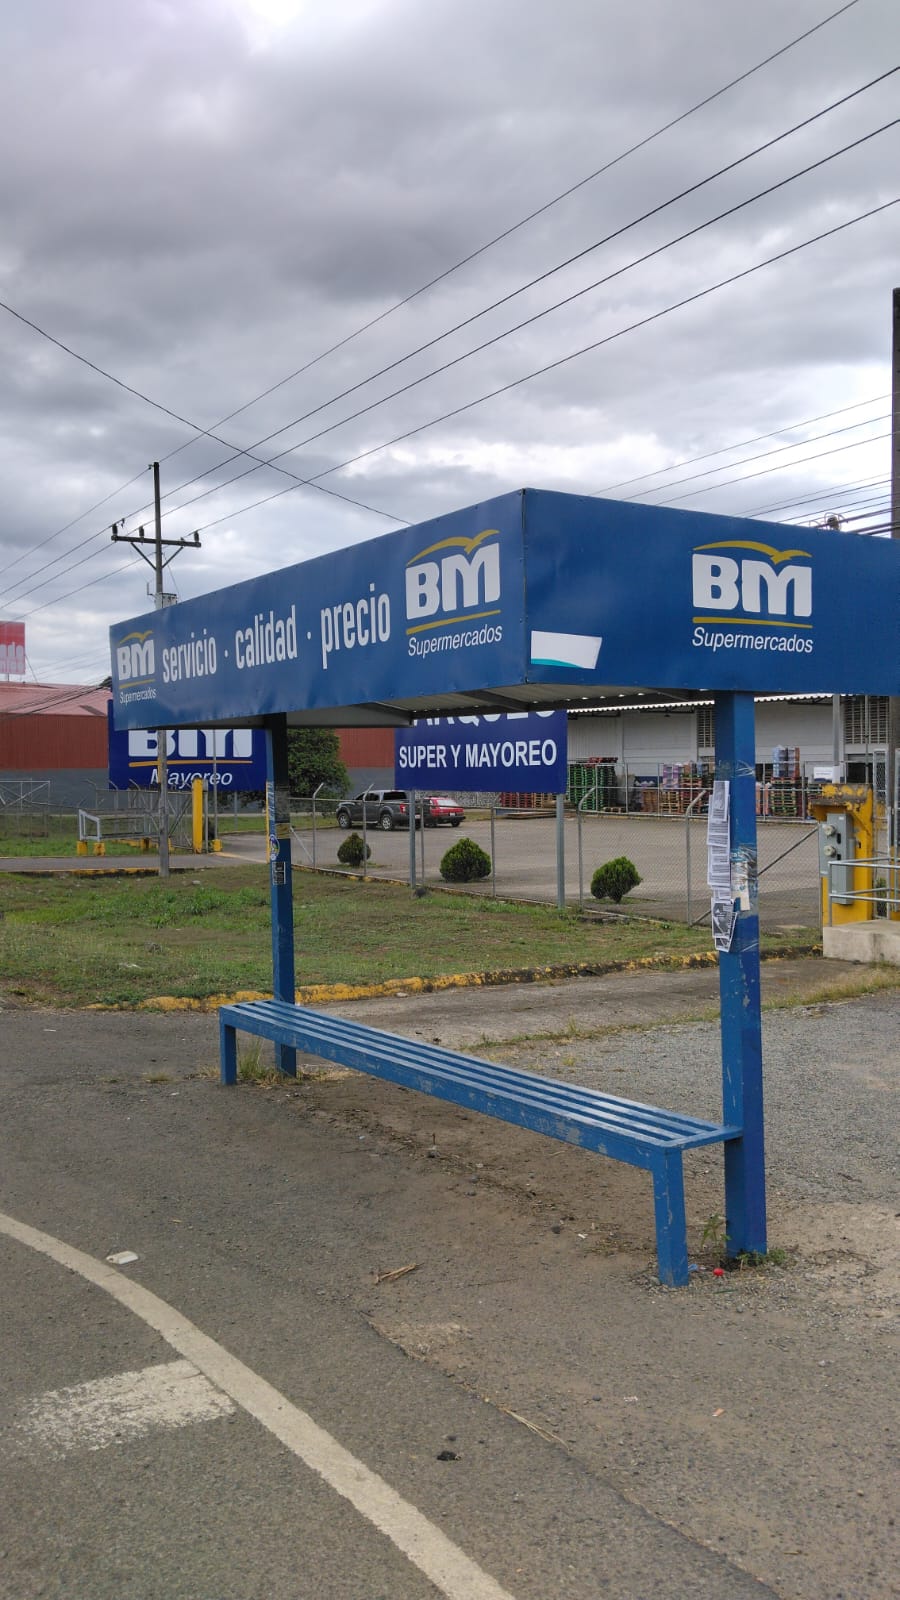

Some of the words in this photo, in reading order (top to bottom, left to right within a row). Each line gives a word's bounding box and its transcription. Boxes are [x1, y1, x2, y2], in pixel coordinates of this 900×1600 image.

[405, 542, 500, 620] BM
[692, 553, 812, 617] BM
[162, 628, 217, 683] servicio
[235, 605, 298, 670] calidad
[320, 583, 391, 669] precio
[407, 623, 503, 657] Supermercados
[692, 626, 814, 653] Supermercados
[117, 639, 155, 681] BM
[399, 744, 447, 769] SUPER
[450, 744, 462, 768] Y
[465, 738, 557, 768] MAYOREO
